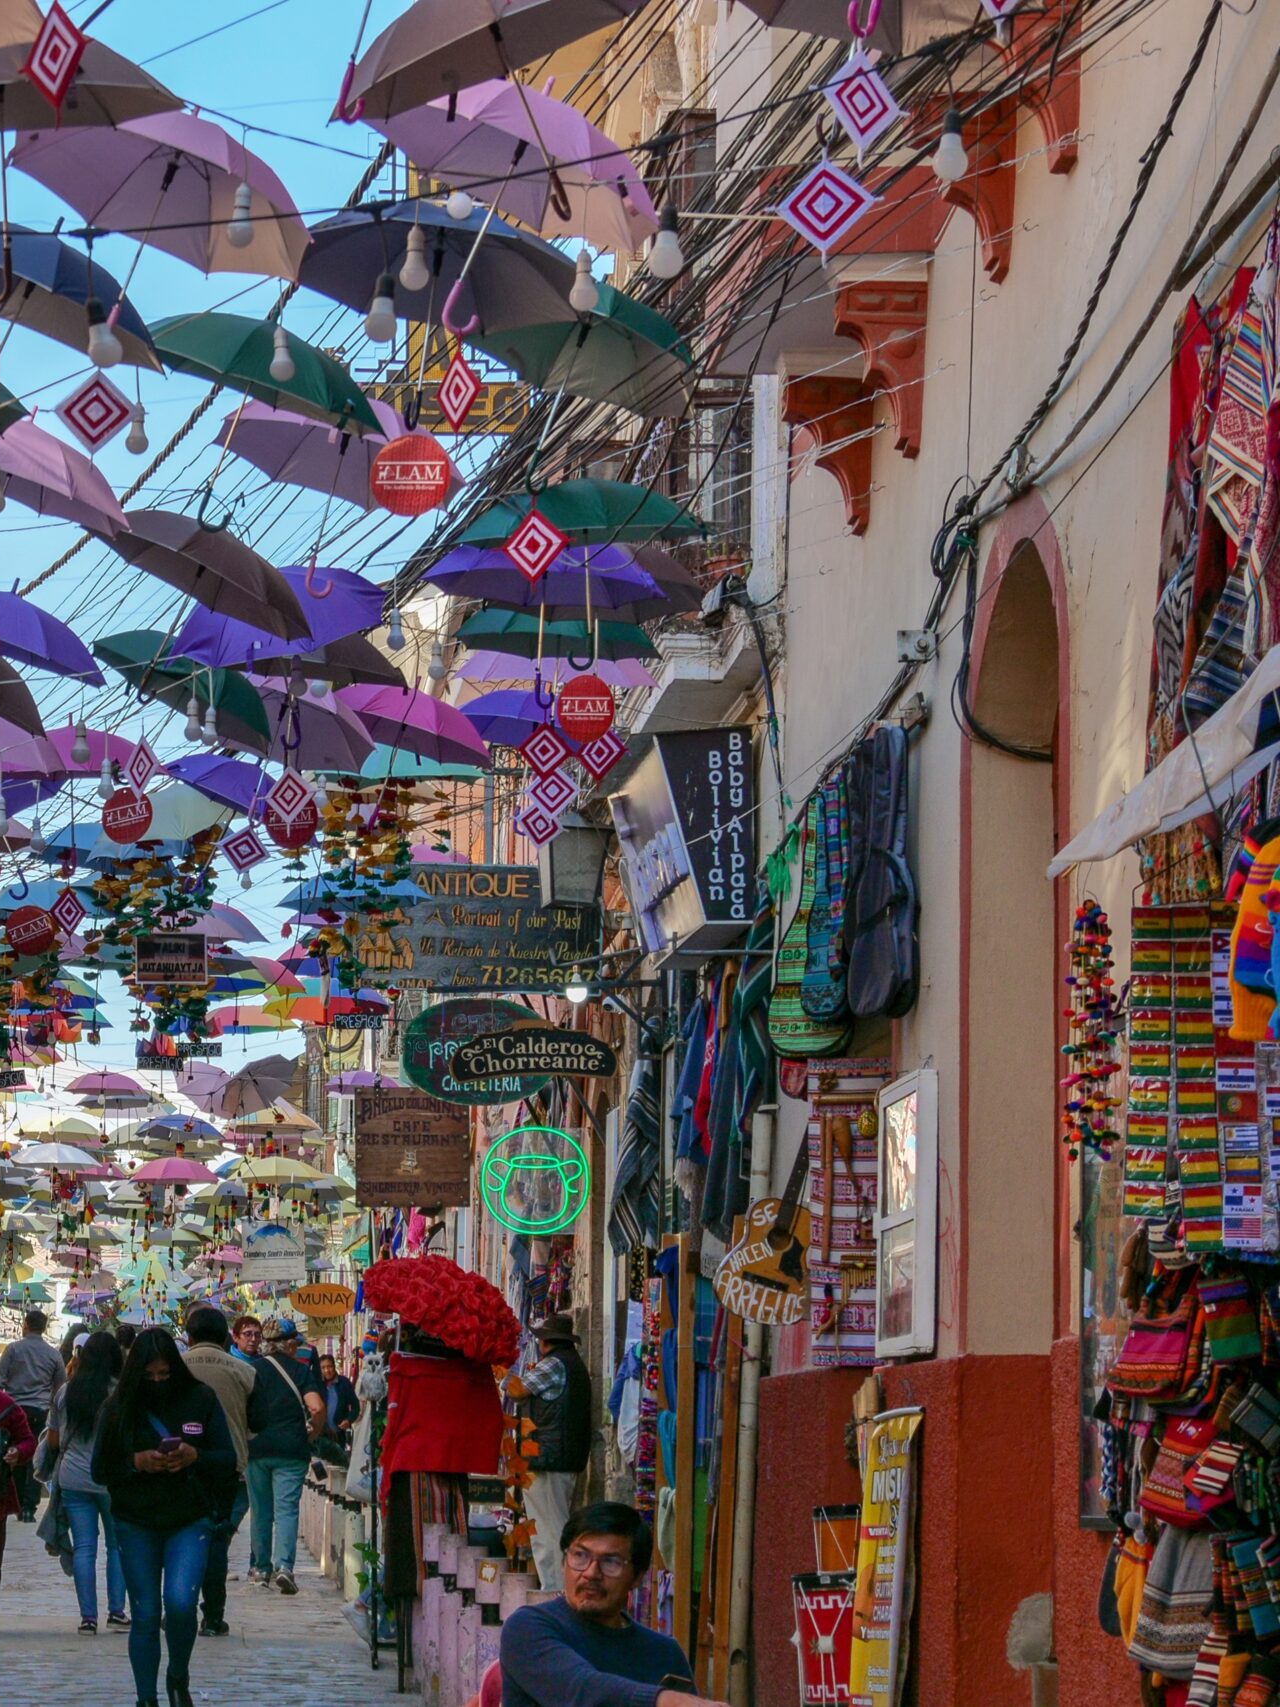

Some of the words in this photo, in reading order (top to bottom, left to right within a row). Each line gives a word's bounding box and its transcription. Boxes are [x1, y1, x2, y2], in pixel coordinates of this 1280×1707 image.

[727, 732, 745, 808] Baby
[708, 751, 725, 901] Bolivian
[727, 814, 747, 919] Alpaca
[417, 872, 530, 898] ANTIQUE
[451, 904, 502, 929] Portrait
[508, 909, 522, 935] of
[527, 910, 548, 929] our
[553, 908, 583, 930] Past
[441, 937, 484, 959] Retrato
[491, 938, 502, 959] de
[505, 940, 550, 961] Nuestro
[397, 978, 434, 989] OMAR
[334, 1014, 384, 1029] PRESAGIO
[177, 1043, 222, 1057] PRESAGIO
[483, 1038, 497, 1049] El
[498, 1037, 587, 1056] Caldero
[138, 1056, 183, 1070] PRESAGIO
[470, 1053, 600, 1075] Chorreante
[392, 1120, 432, 1132] CAFE
[362, 1133, 461, 1146] RESTAURANT
[751, 1202, 778, 1227] SE
[729, 1238, 774, 1273] HACEN
[297, 1292, 353, 1308] MUNAY
[715, 1269, 806, 1326] ARREGLOS
[860, 1625, 867, 1639] Y
